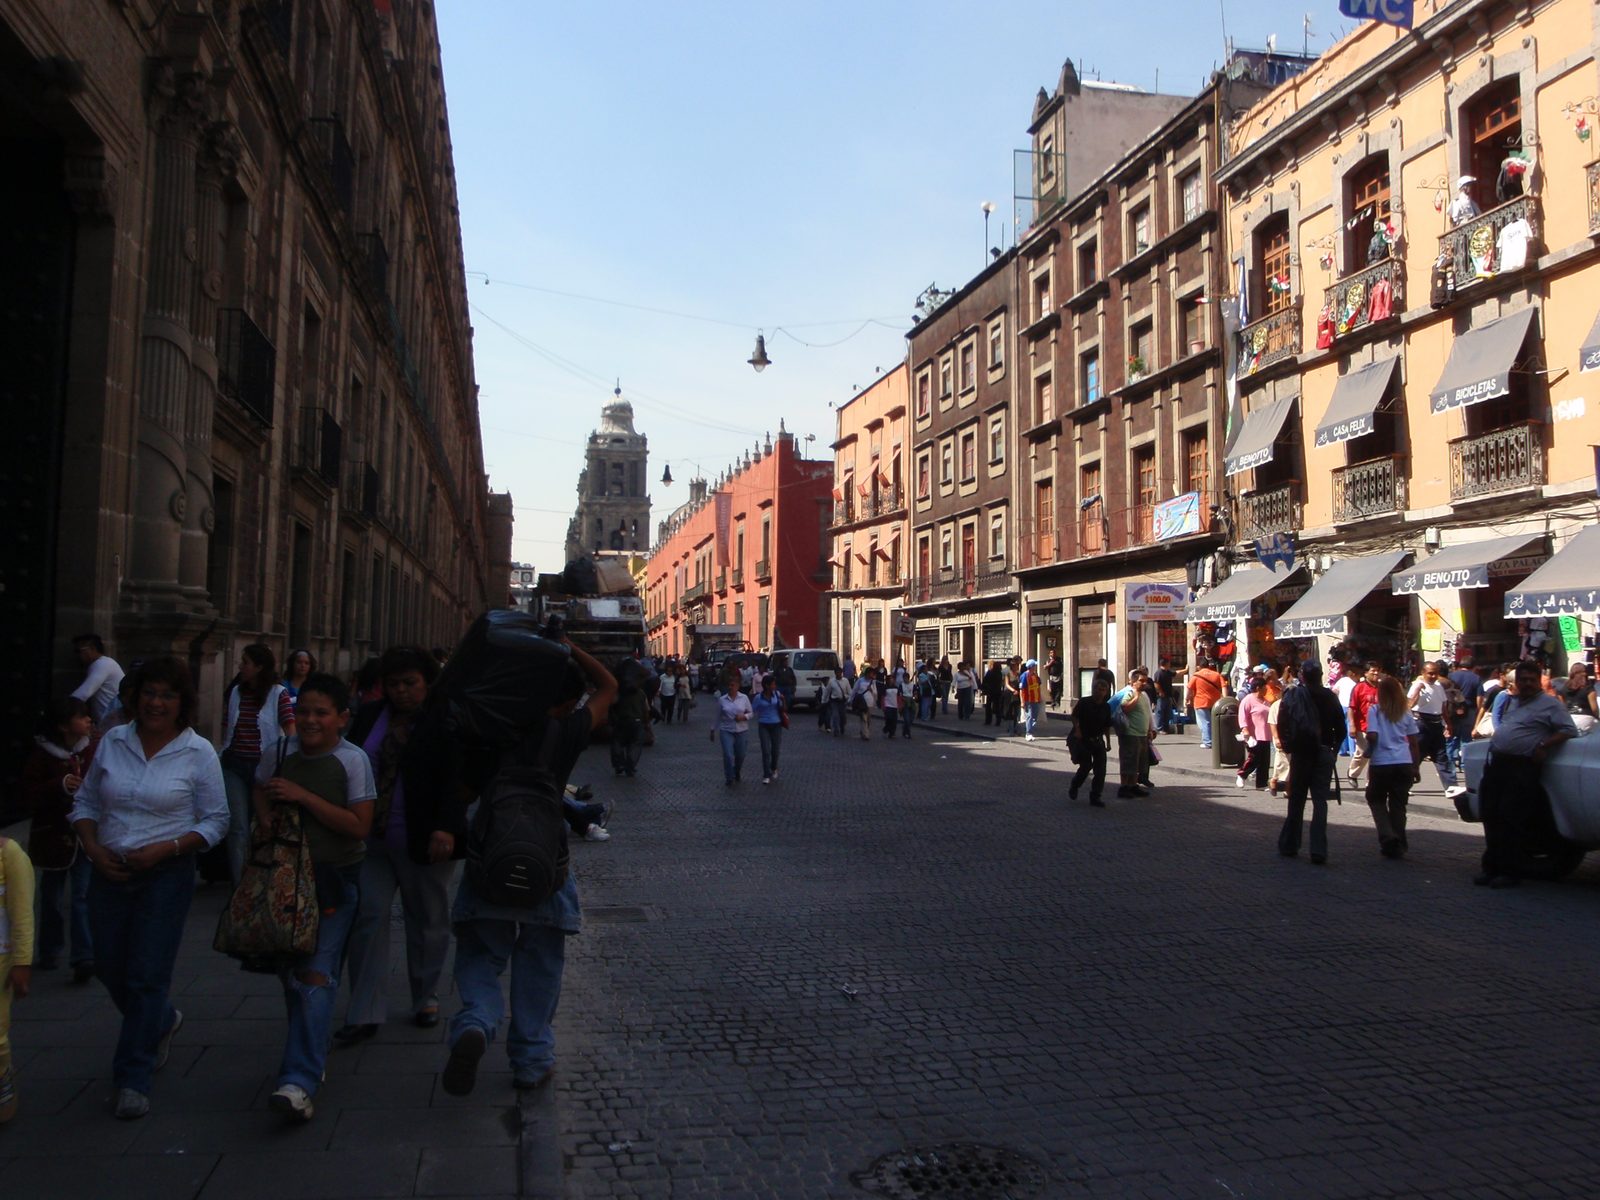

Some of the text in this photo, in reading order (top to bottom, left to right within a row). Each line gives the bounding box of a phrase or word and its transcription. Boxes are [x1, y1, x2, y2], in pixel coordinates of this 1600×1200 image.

[1455, 378, 1497, 401] BICICLETAS
[1332, 417, 1366, 437] CASA FELIX
[1239, 447, 1269, 466] BENOTTO
[1423, 569, 1470, 585] BENOTTO
[1207, 605, 1236, 616] BENOTTO
[1300, 619, 1331, 631] BICICLETAS
